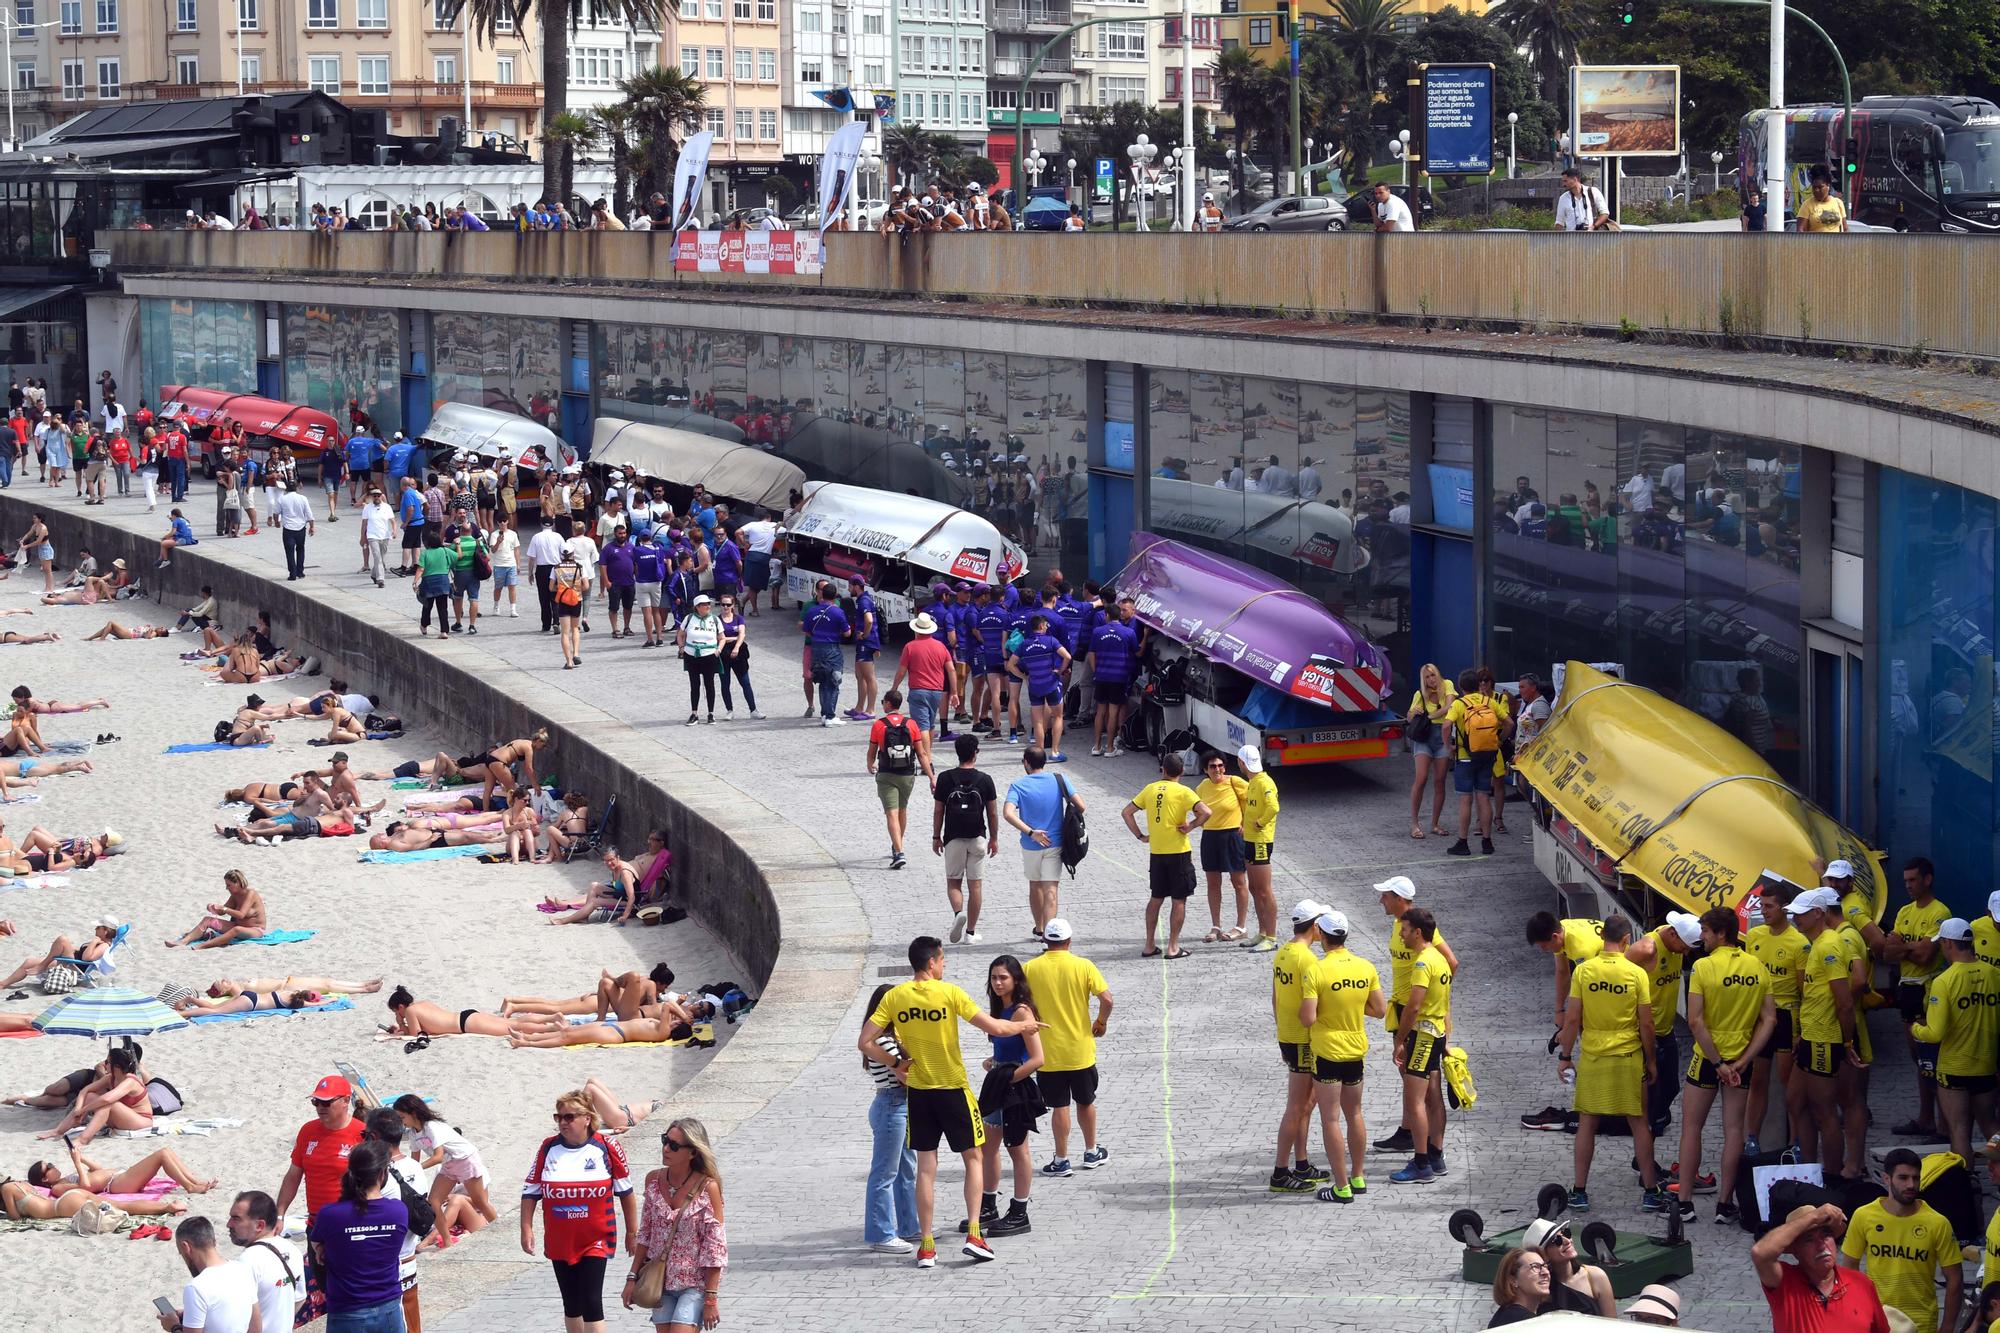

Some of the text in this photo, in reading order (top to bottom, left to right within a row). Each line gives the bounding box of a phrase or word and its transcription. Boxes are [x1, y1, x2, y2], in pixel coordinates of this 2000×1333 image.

[1100, 160, 1110, 174] P
[1301, 670, 1325, 687] LIGA
[1315, 730, 1356, 741] 8383 GCR
[1155, 793, 1164, 823] ORIO
[1660, 853, 1735, 910] SAGARDI
[1331, 978, 1369, 992] ORIO!
[1588, 981, 1628, 995] ORIO!
[1723, 974, 1760, 987] ORIO!
[897, 1006, 947, 1024] ORIO!
[972, 1107, 984, 1139] ORIO
[567, 1210, 589, 1219] korda
[1870, 1244, 1929, 1263] ORIALKI
